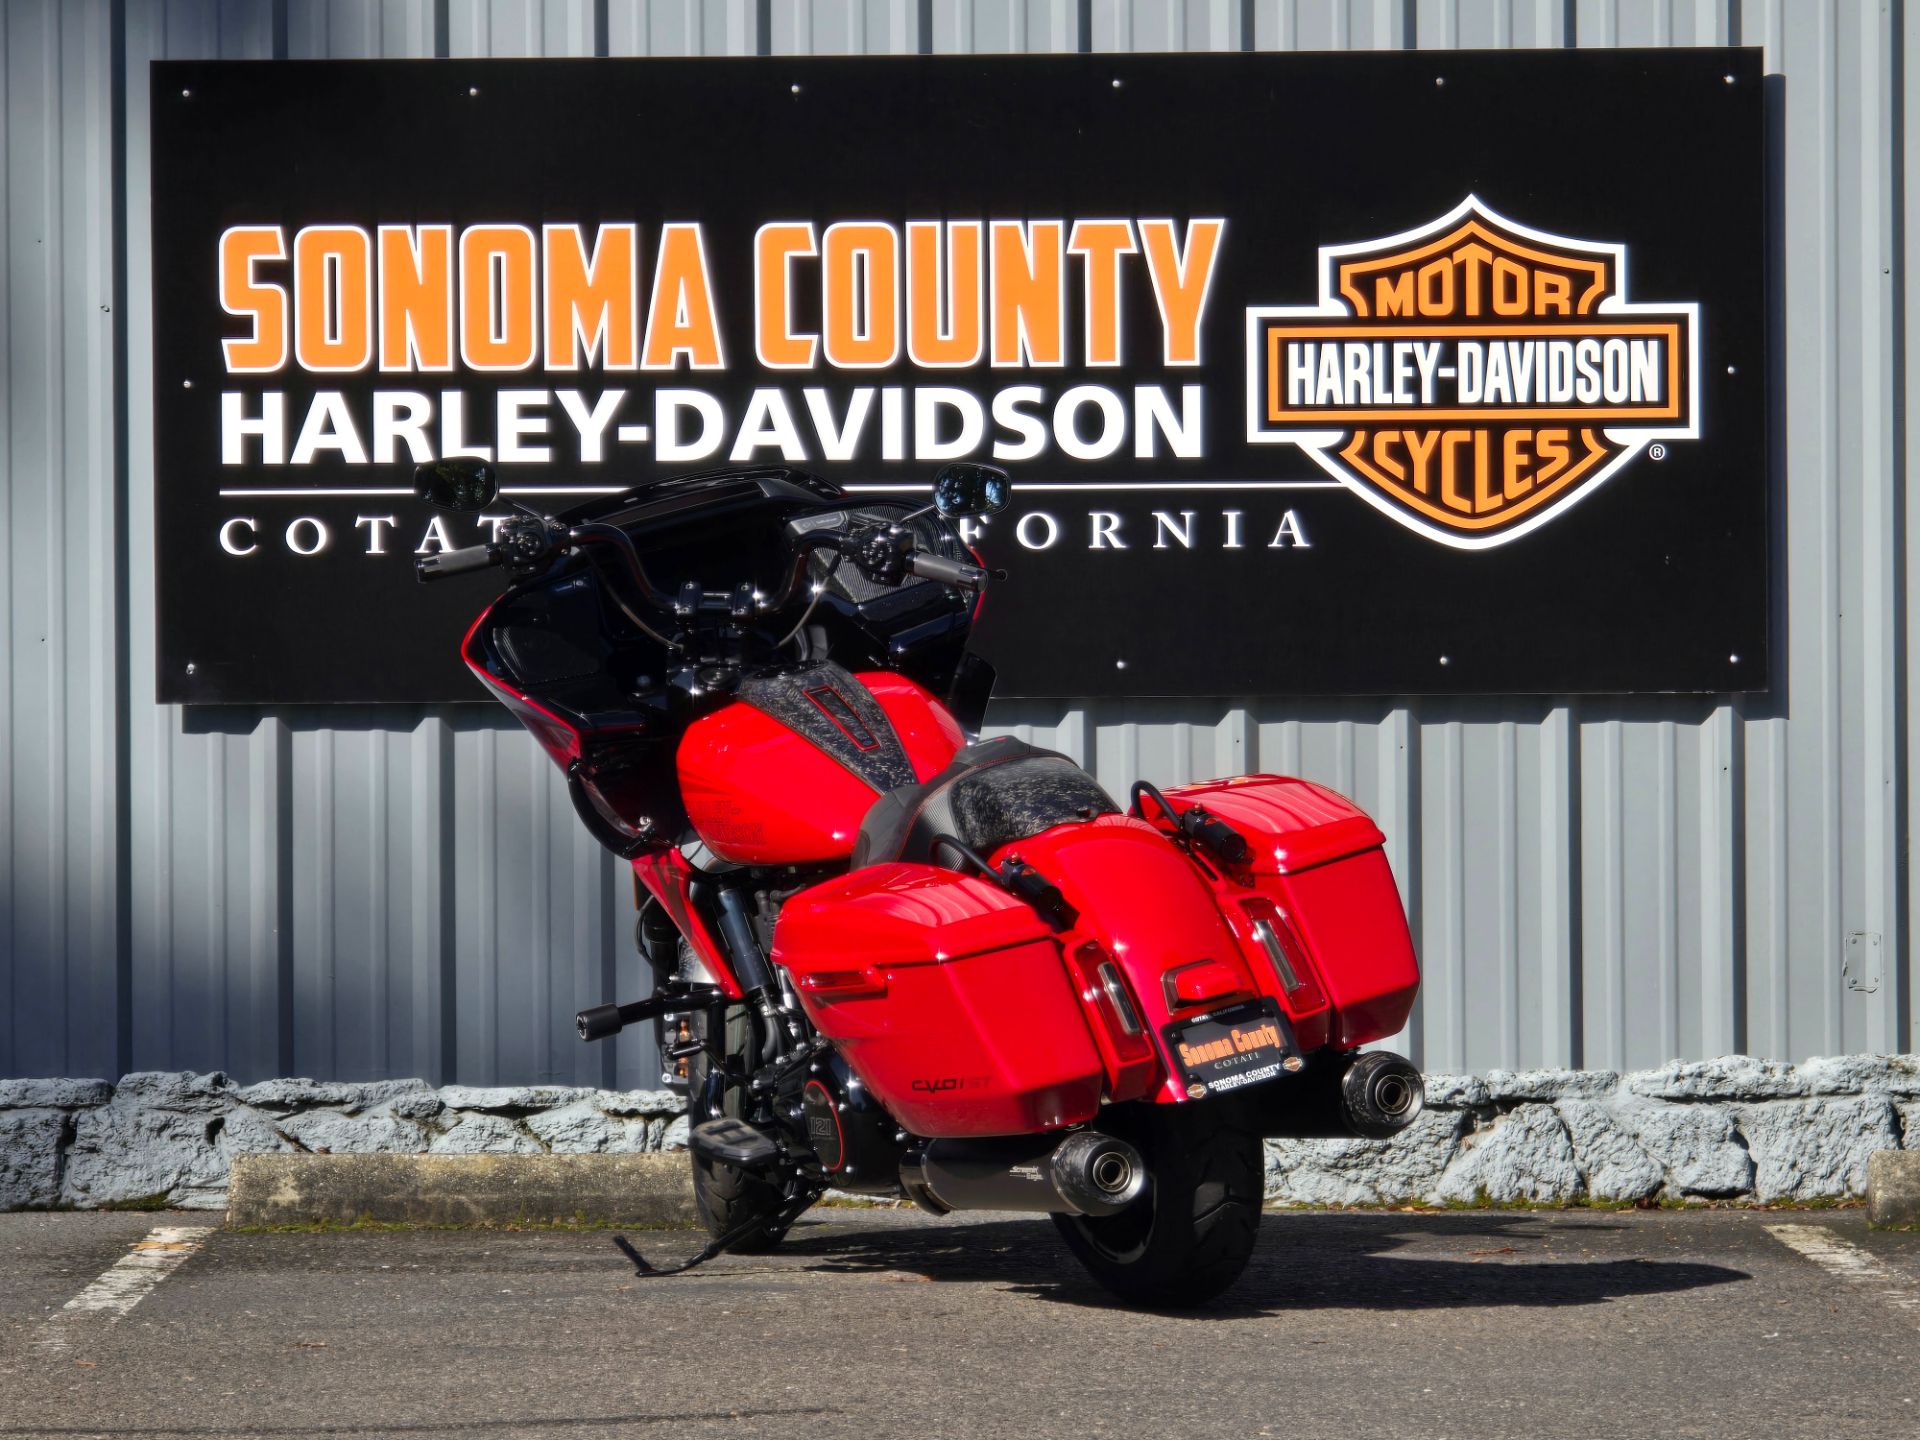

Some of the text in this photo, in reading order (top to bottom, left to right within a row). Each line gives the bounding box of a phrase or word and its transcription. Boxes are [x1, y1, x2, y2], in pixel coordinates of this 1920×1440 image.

[219, 218, 1226, 373] SONOMA COUNTY
[1375, 242, 1570, 317] MOTOR
[1287, 338, 1660, 404] HARLEY-DAVIDSON
[220, 383, 1204, 464] HARLEY-DAVIDSON
[1373, 429, 1569, 514] CYCLES
[219, 513, 514, 556] COTAT
[1179, 1024, 1280, 1067] Sonoma County
[1208, 1073, 1245, 1089] SONOMA
[1245, 1063, 1280, 1078] COUNTY
[1214, 1051, 1261, 1069] COTATI
